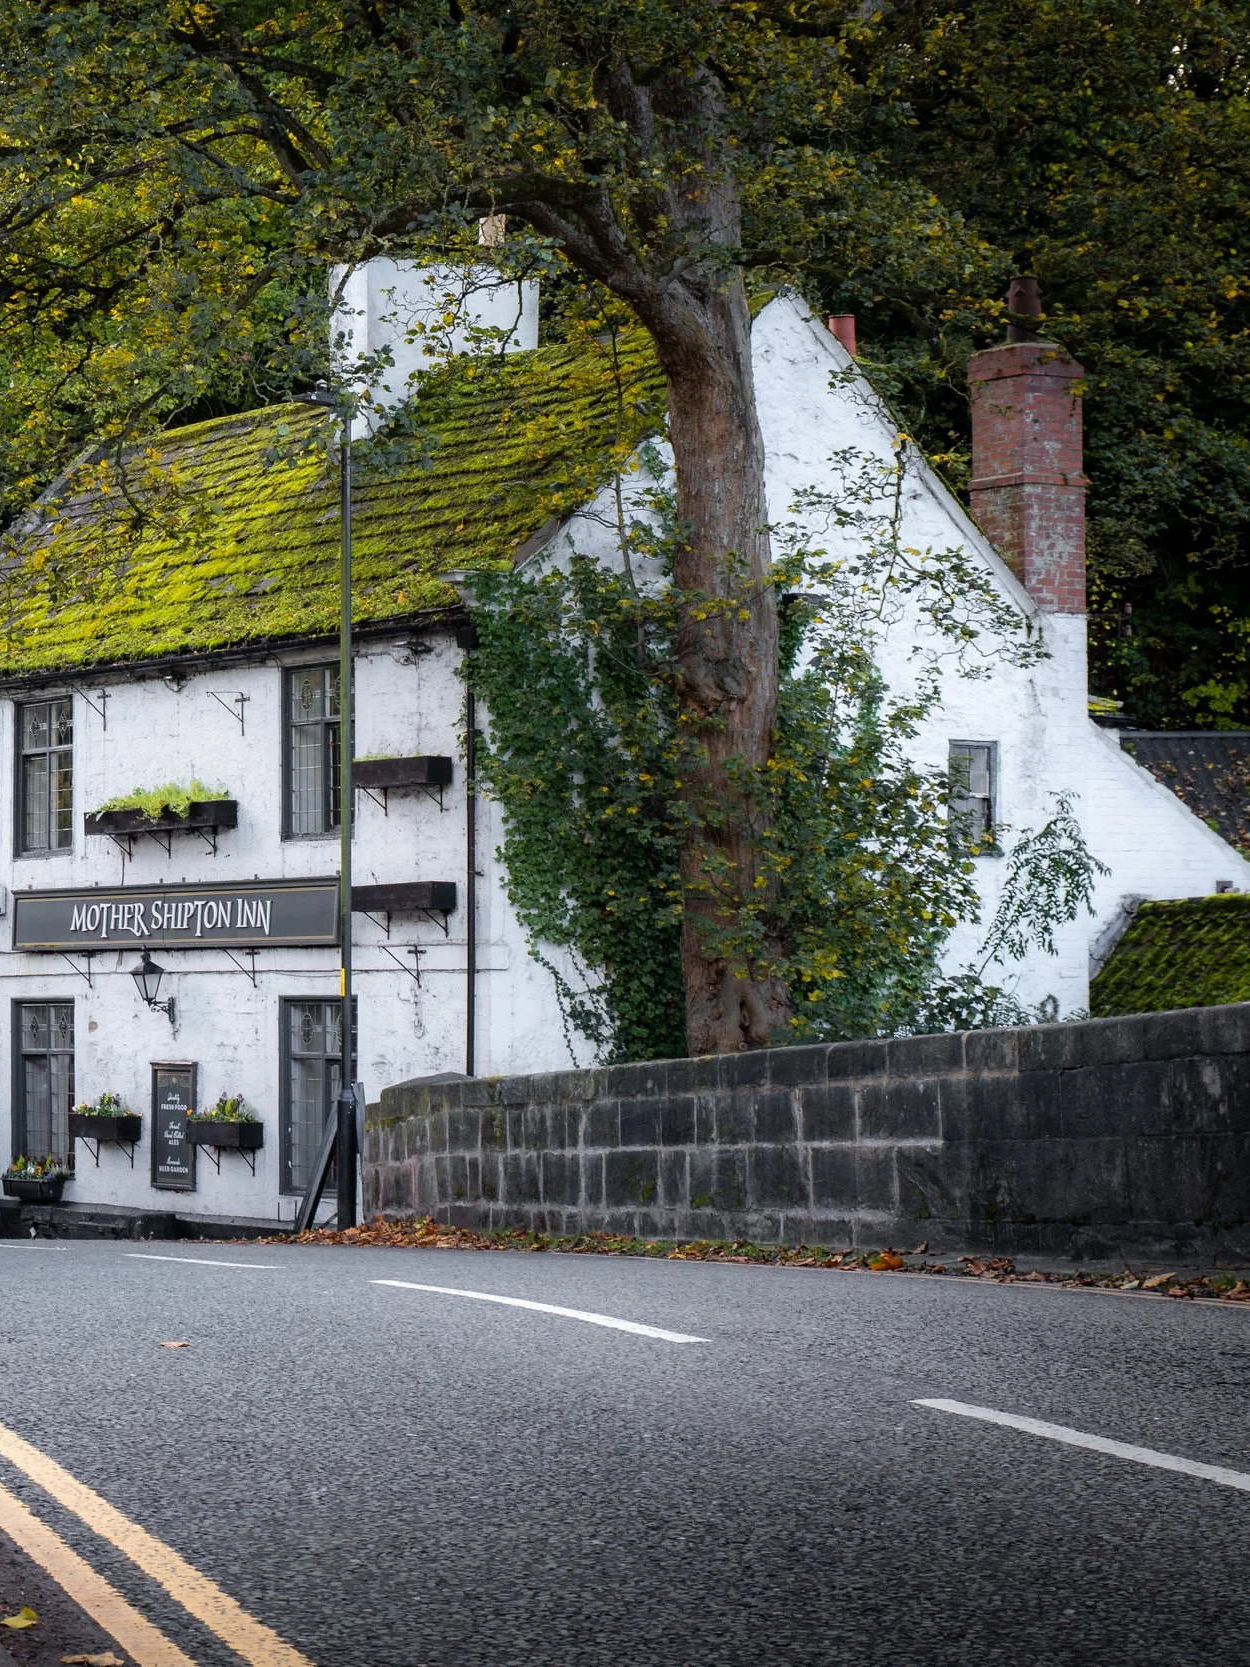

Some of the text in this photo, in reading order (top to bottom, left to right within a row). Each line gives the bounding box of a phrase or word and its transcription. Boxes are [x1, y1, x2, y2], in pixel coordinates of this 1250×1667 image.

[69, 898, 273, 939] MOTHER SHIPTON INN
